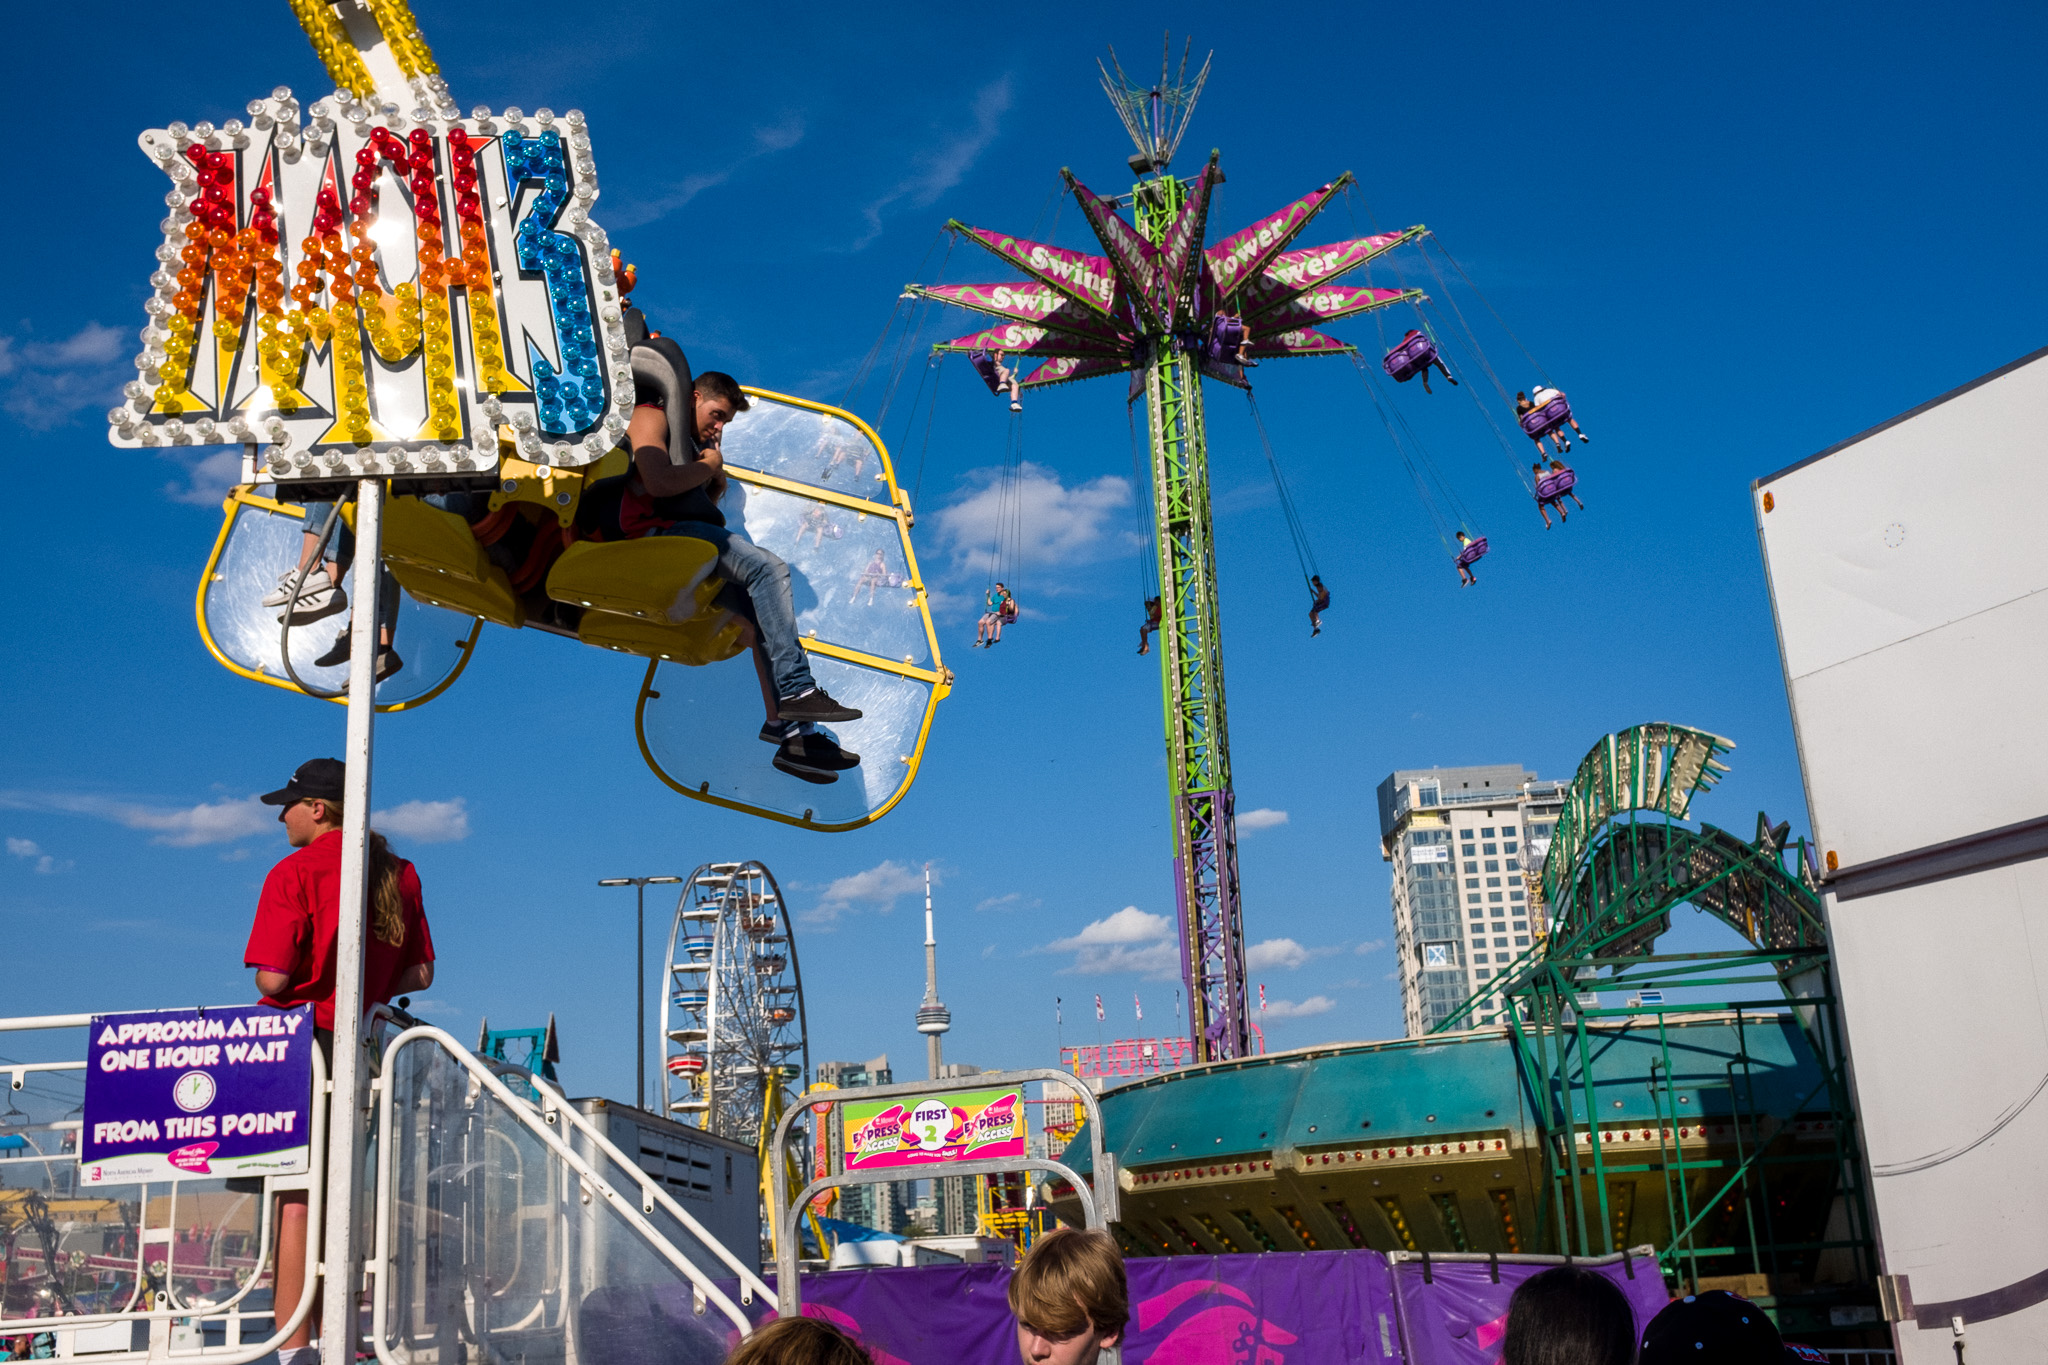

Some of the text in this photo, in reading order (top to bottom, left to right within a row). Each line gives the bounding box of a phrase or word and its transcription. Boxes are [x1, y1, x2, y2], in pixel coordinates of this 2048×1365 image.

[1106, 214, 1155, 287] Swing
[1210, 218, 1284, 286] Tower
[1029, 246, 1116, 306] Swing
[97, 1013, 304, 1046] APPROXIMATELY
[100, 1040, 289, 1072] ONE HOUR WAIT
[93, 1110, 297, 1144] FROM THIS POINT
[915, 1109, 947, 1122] FIRST
[964, 1112, 1014, 1139] EXPRESS
[852, 1123, 900, 1149] EXPRESS
[865, 1137, 899, 1153] ACCESS
[924, 1125, 937, 1143] 2
[977, 1126, 1013, 1143] ACCESS
